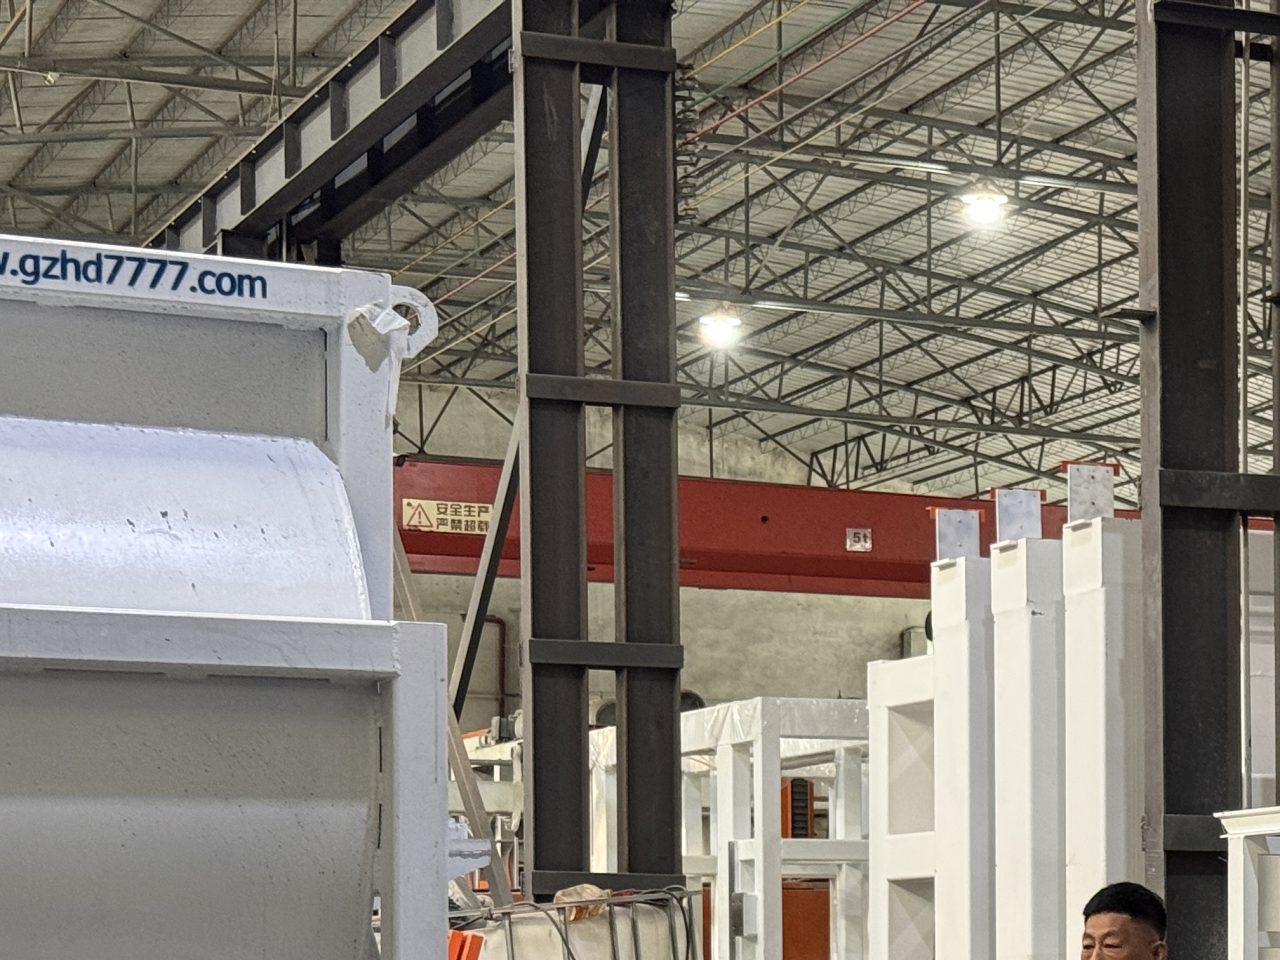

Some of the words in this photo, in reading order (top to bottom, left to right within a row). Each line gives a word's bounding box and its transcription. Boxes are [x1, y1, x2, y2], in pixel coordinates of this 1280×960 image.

[436, 503, 490, 518] 安全生产
[436, 518, 490, 532] 严禁超载
[853, 532, 869, 544] 5t
